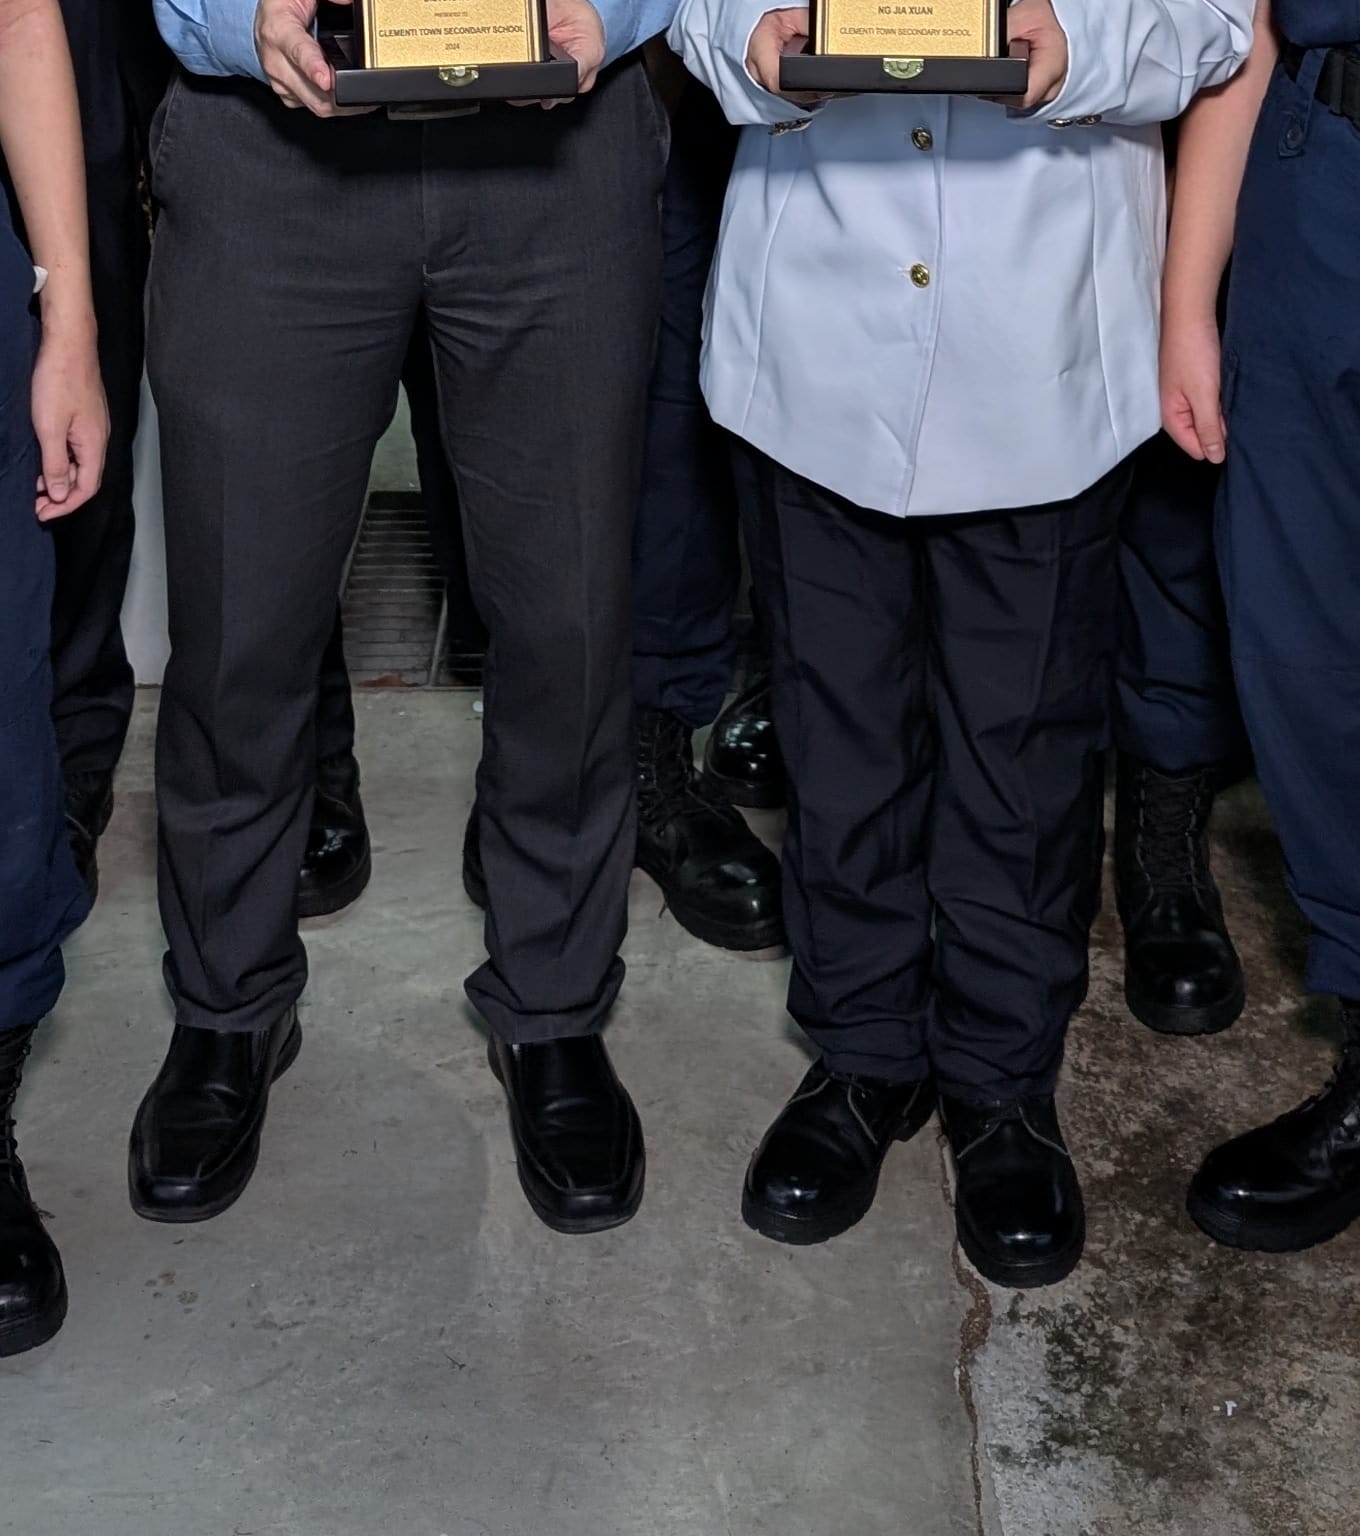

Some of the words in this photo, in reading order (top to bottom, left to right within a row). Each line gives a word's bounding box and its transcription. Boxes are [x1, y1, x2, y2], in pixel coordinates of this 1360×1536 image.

[878, 6, 891, 15] NG
[893, 6, 907, 15] JIA
[908, 6, 933, 15] XUAN
[379, 28, 418, 37] CLEMENTI
[420, 28, 442, 36] TOWN
[444, 26, 491, 35] SECONDARY
[492, 25, 525, 34] SCHOOL
[840, 27, 875, 35] CLEMENTI
[876, 27, 897, 35] TOWN
[898, 28, 941, 36] SECONDARY
[942, 28, 972, 37] SCHOOL
